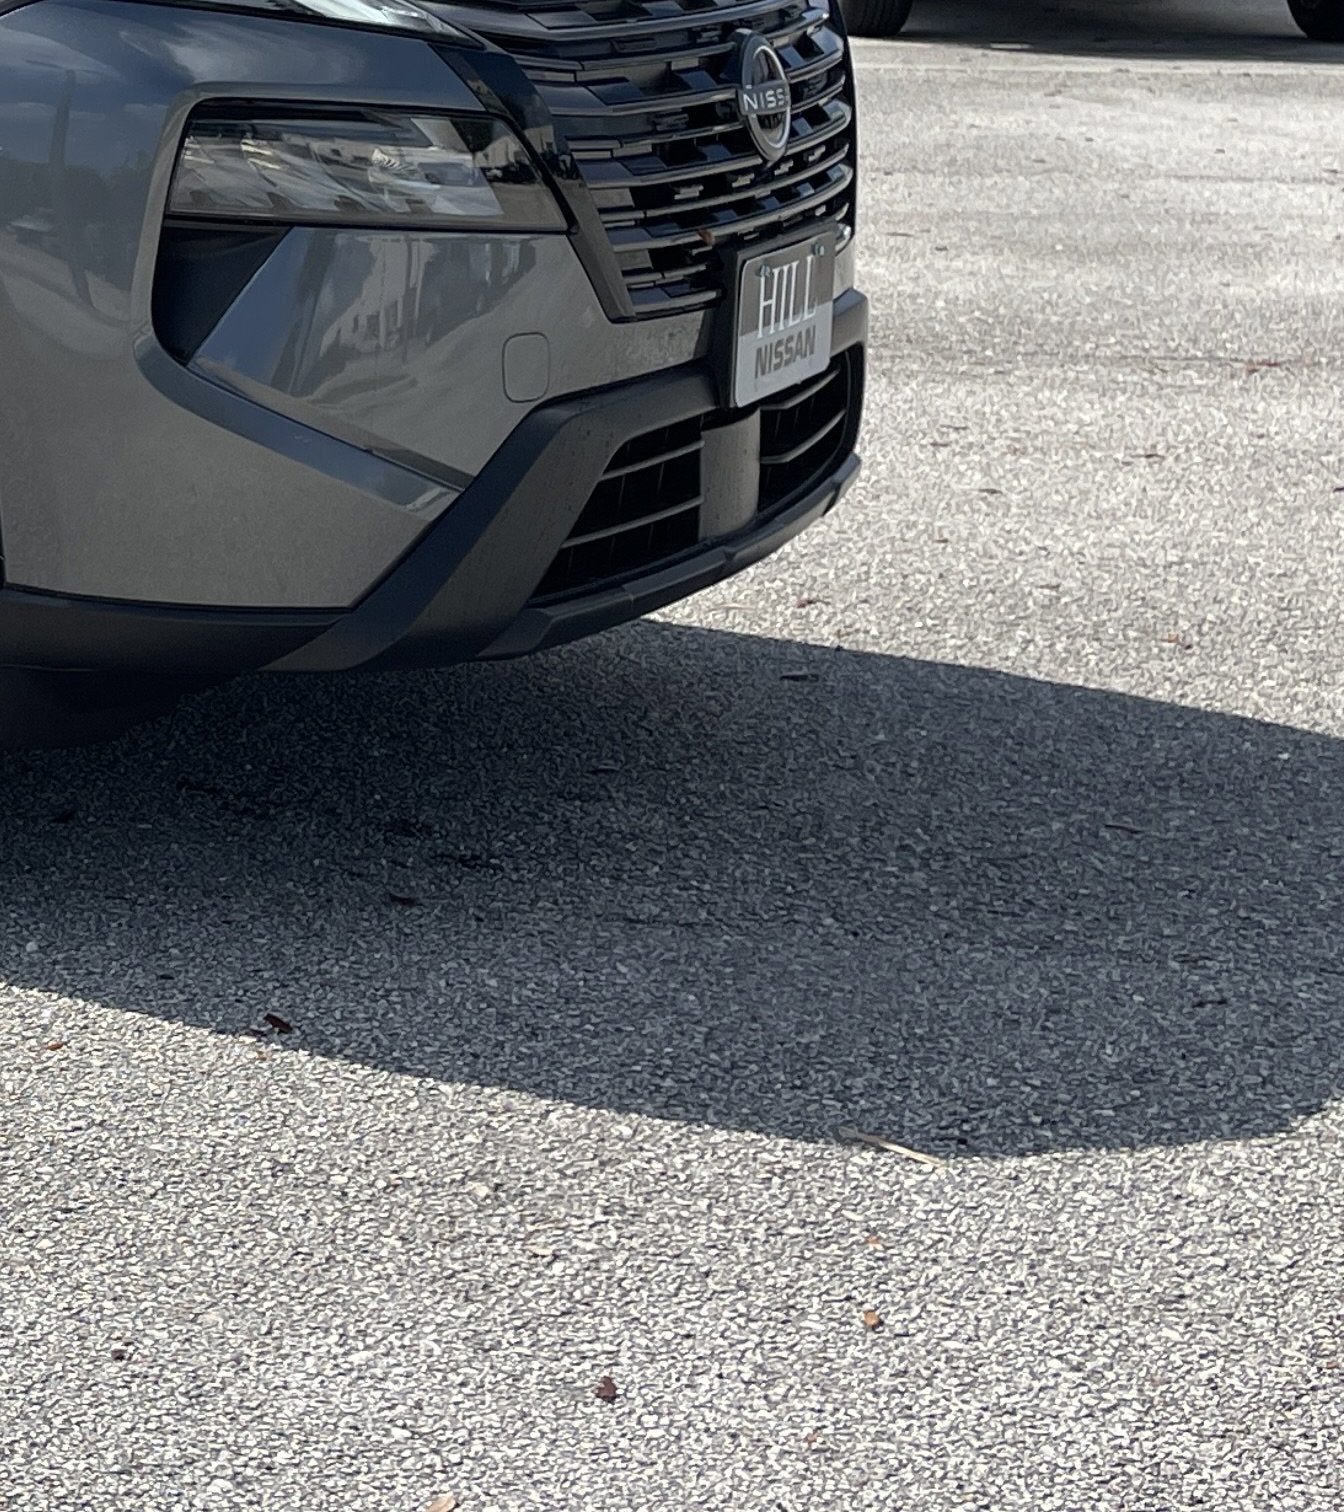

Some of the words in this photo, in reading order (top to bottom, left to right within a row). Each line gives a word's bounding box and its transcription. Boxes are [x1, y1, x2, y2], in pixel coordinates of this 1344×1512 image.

[742, 88, 787, 111] NISS
[757, 255, 817, 338] HILL
[755, 325, 816, 379] NISSAN
